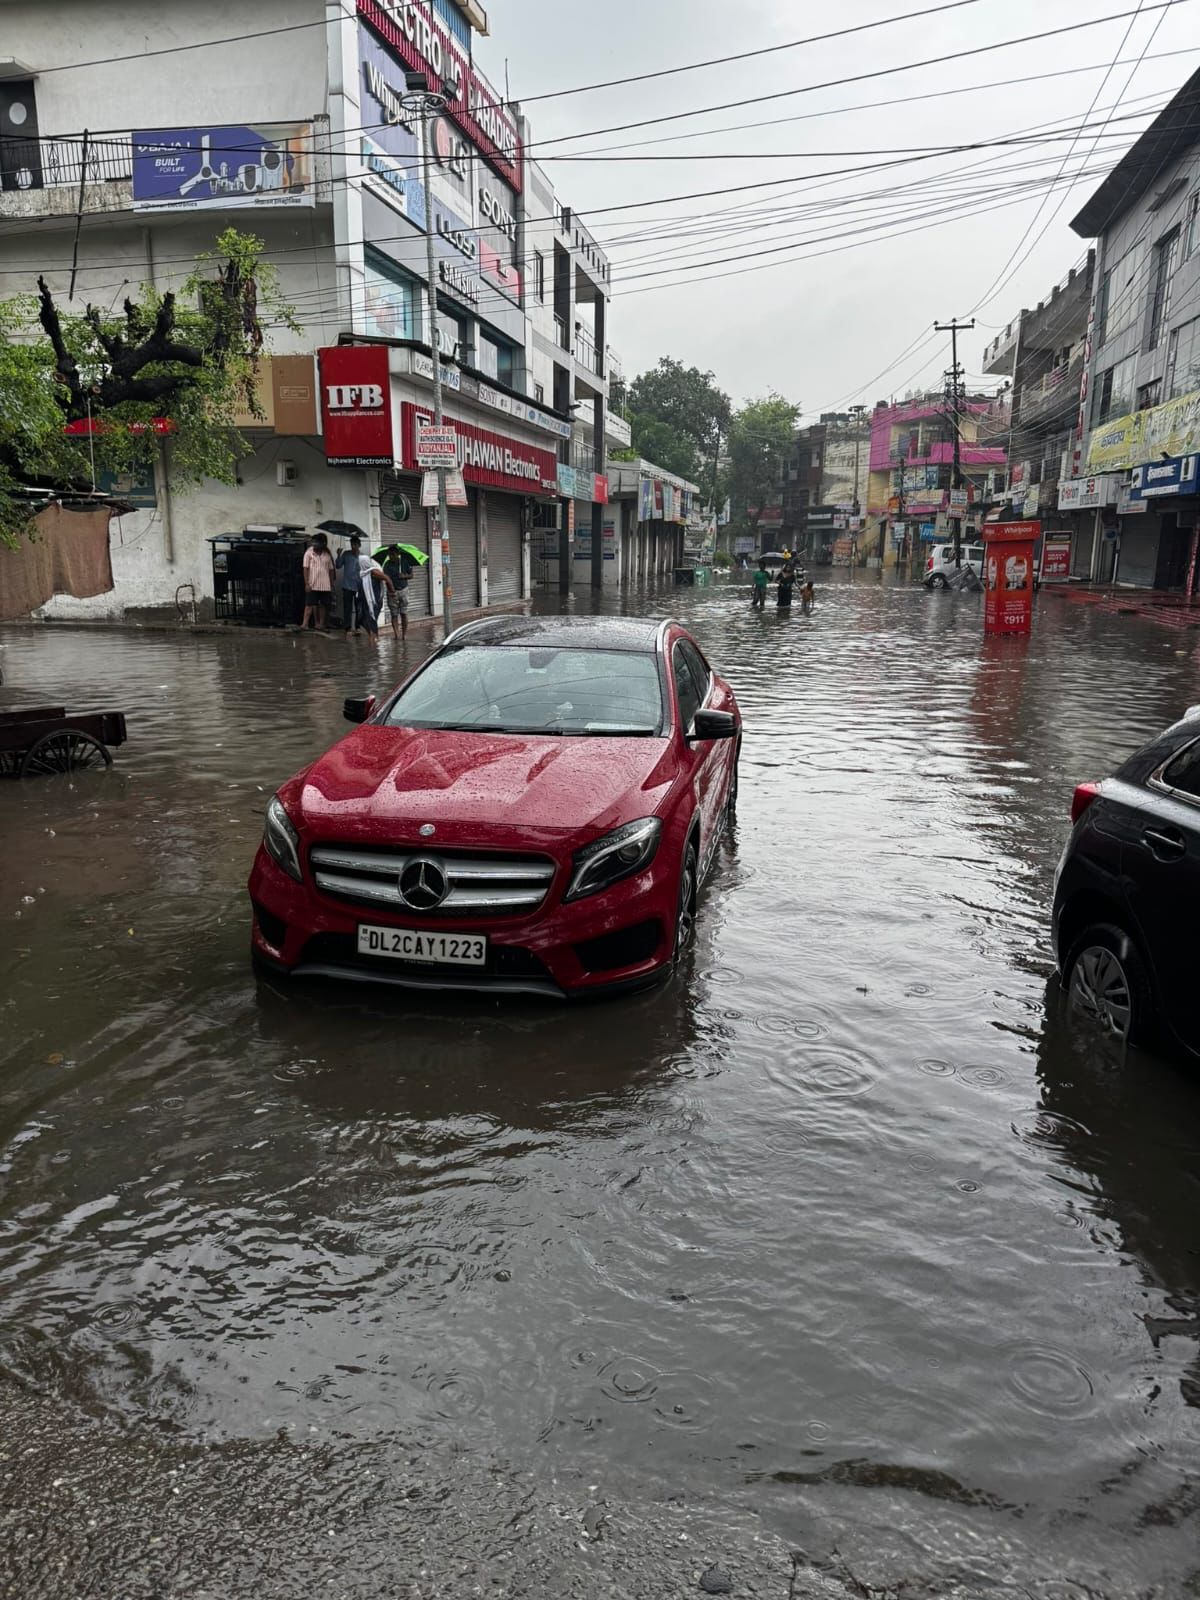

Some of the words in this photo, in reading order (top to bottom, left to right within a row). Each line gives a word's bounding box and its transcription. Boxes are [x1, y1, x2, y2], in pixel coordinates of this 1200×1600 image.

[375, 0, 463, 101] ECTRONIC
[467, 80, 518, 168] PARADISE
[155, 157, 181, 167] BUILT
[480, 187, 517, 242] SONY
[438, 213, 476, 260] LLOYD
[326, 384, 384, 408] IFB
[356, 457, 392, 465] Electronics
[420, 443, 454, 453] VIDYANJALI
[504, 448, 541, 481] Electronics
[1004, 525, 1032, 534] Whirlpool
[368, 930, 484, 960] DL2CAY1223
